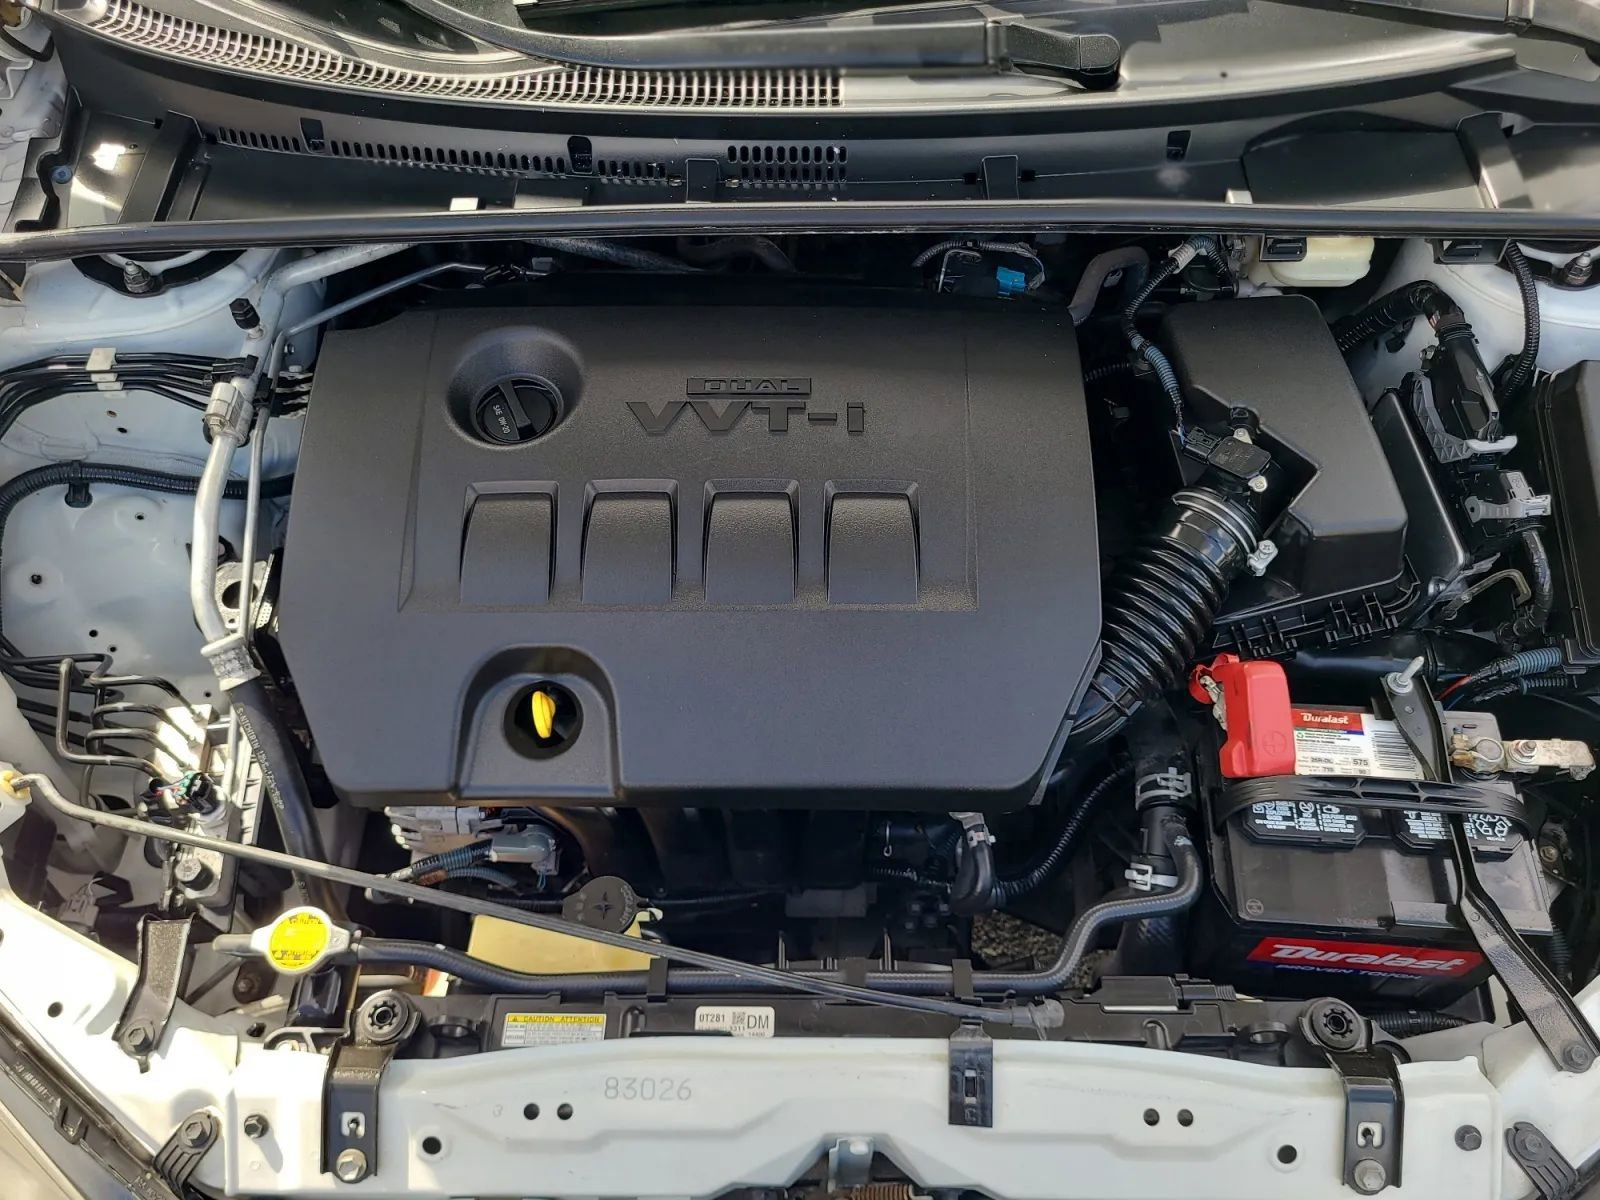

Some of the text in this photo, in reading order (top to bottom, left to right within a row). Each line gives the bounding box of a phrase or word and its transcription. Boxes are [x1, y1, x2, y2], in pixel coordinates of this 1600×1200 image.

[704, 379, 800, 390] DUAL
[1300, 712, 1349, 724] Duralast
[1271, 944, 1467, 970] Duralast
[1275, 963, 1423, 980] PROVEN TOUGH
[523, 1015, 600, 1024] CAUTION ATTENTION
[747, 1015, 769, 1029] DM
[604, 1076, 692, 1101] 83026
